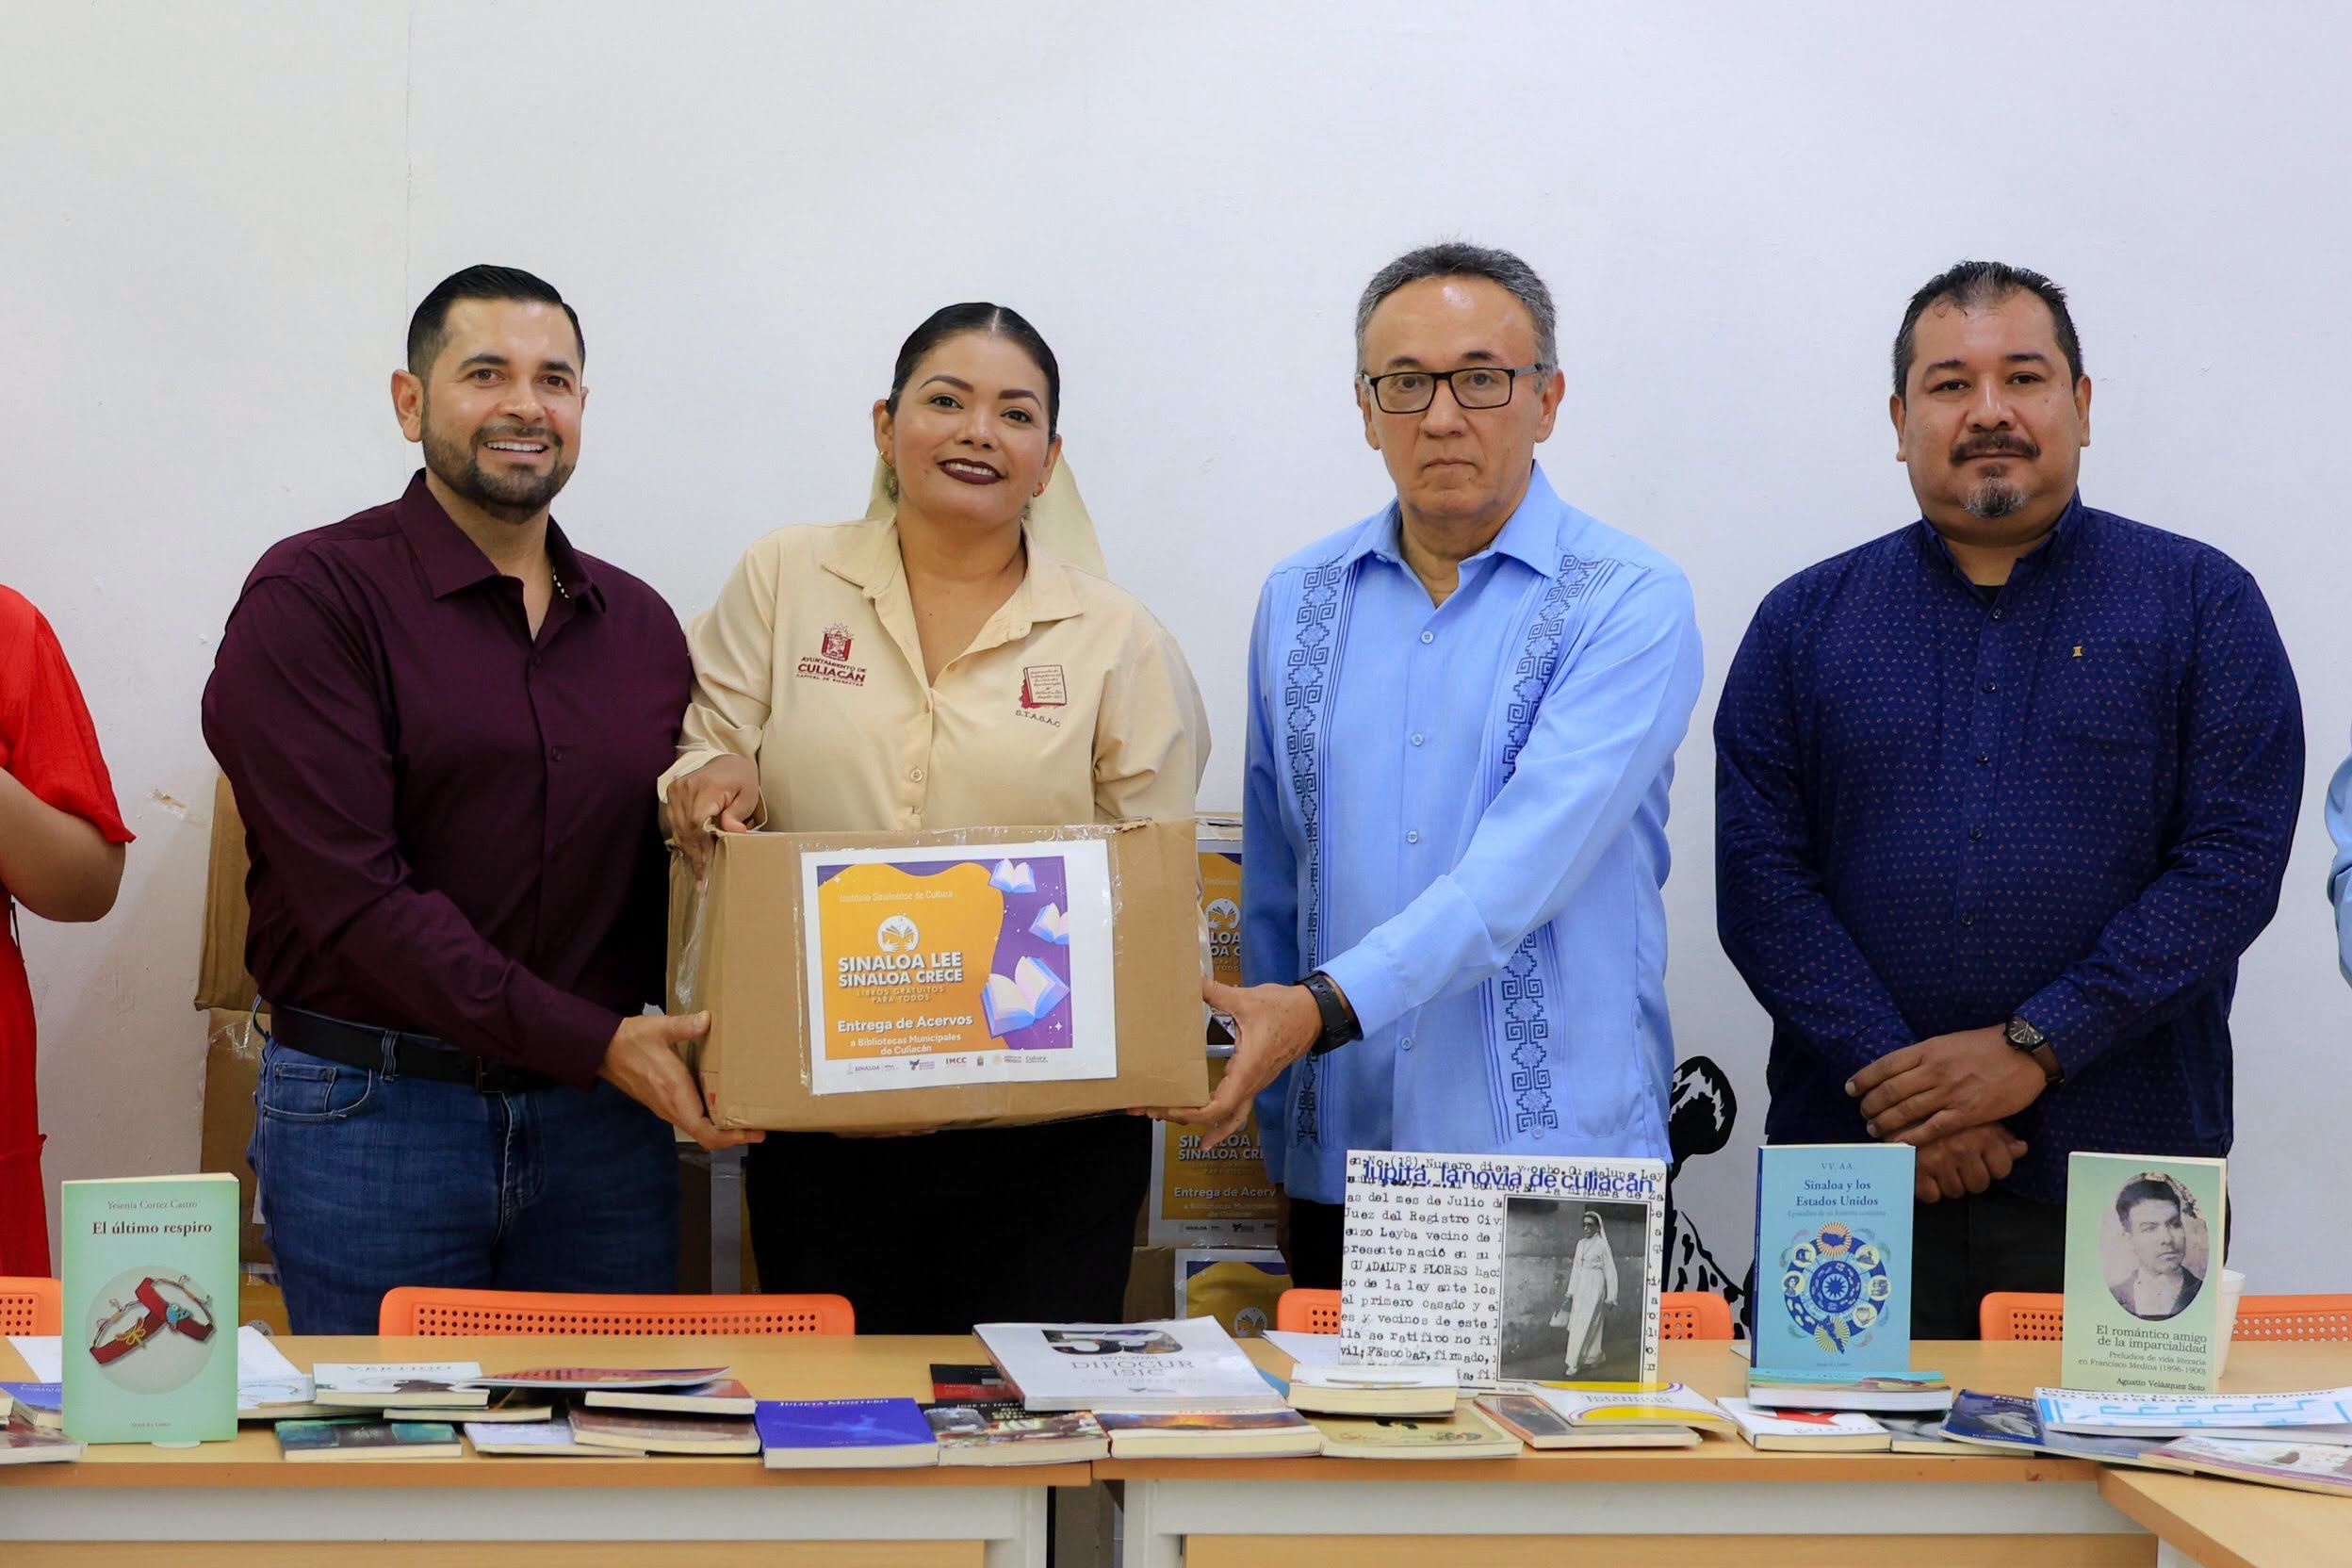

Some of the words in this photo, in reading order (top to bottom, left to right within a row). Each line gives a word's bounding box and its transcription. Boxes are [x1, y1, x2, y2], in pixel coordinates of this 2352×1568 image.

[801, 656, 856, 671] AYUNTAMIENTO
[915, 891, 924, 900] de
[925, 890, 954, 899] Cultura
[838, 953, 926, 972] SINALOA
[931, 951, 963, 969] LEE
[839, 971, 911, 988] SINALOA
[916, 969, 963, 984] CRECE
[855, 987, 889, 996] LIBROS
[892, 986, 944, 996] GRATUITOS
[872, 995, 894, 1004] PARA
[899, 994, 930, 1003] TODOS
[837, 1020, 893, 1034] Entrega
[896, 1018, 913, 1029] de
[917, 1015, 973, 1029] Acervos
[858, 1037, 906, 1047] Bibliotecas
[909, 1033, 961, 1044] Municipales
[894, 1044, 932, 1054] Culiacán
[1178, 1149, 1238, 1161] SINALOA
[1529, 1168, 1558, 1188] de
[1174, 1187, 1220, 1199] Entrega
[1225, 1187, 1237, 1197] de
[1804, 1179, 1843, 1191] Sinaloa
[1846, 1182, 1854, 1193] y
[1855, 1179, 1871, 1190] los
[106, 1200, 138, 1210] Yesenia
[1369, 1192, 1390, 1203] del
[1396, 1196, 1419, 1205] mes
[1427, 1195, 1442, 1205] de
[1447, 1196, 1485, 1207] Julio
[1796, 1195, 1838, 1207] Estados
[1840, 1195, 1879, 1206] Unidos
[1345, 1207, 1375, 1219] Juez
[1382, 1210, 1402, 1221] del
[1410, 1211, 1470, 1225] Registro
[91, 1220, 106, 1234] El
[111, 1220, 159, 1234] último
[163, 1220, 213, 1237] respiro
[1380, 1227, 1418, 1240] Leyba
[1427, 1231, 1469, 1242] vecino
[1477, 1232, 1491, 1243] de
[1408, 1247, 1446, 1258] nació
[1423, 1264, 1468, 1276] FLORES
[1364, 1279, 1378, 1288] de
[1386, 1279, 1400, 1291] la
[1408, 1280, 1429, 1292] ley
[1437, 1282, 1467, 1294] ante
[1474, 1283, 1496, 1296] los
[1342, 1295, 1354, 1304] el
[1362, 1296, 1413, 1307] primero
[1472, 1302, 1481, 1312] y
[1341, 1314, 1356, 1322] es
[1362, 1314, 1371, 1324] y
[1378, 1314, 1429, 1325] vecinos
[1435, 1315, 1450, 1327] de
[1458, 1318, 1487, 1329] este
[1455, 1334, 1471, 1344] no
[2096, 1324, 2108, 1335] El
[2112, 1325, 2170, 1340] romántico
[2172, 1331, 2208, 1345] amigo
[2097, 1335, 2112, 1347] de
[2115, 1336, 2125, 1348] la
[2129, 1337, 2207, 1354] imparcialidad
[1070, 1360, 1197, 1368] DIFOCUR
[2109, 1350, 2145, 1361] Preludios
[2147, 1353, 2156, 1362] de
[2158, 1355, 2175, 1364] vida
[2176, 1356, 2207, 1365] literaria
[2090, 1358, 2128, 1368] Francisco
[2129, 1361, 2157, 1371] Medina
[2159, 1364, 2207, 1376] (1896-1900)
[2187, 1382, 2206, 1392] Soto
